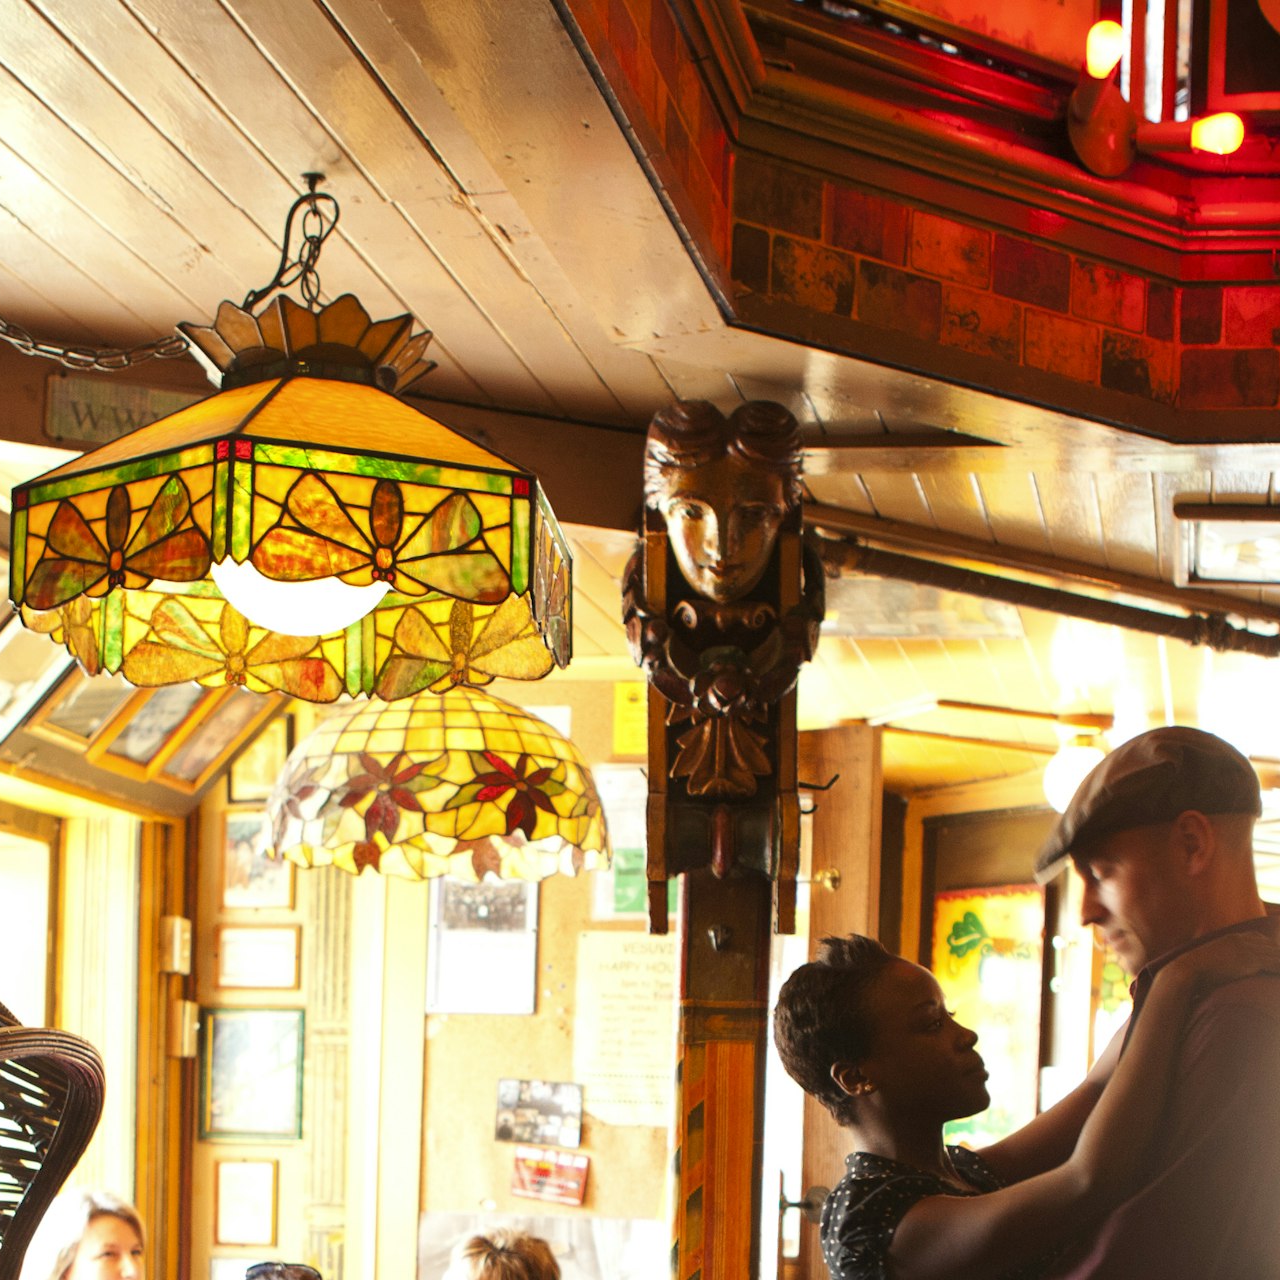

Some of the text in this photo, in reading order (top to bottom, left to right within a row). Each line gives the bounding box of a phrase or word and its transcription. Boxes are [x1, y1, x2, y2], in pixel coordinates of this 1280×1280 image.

[622, 943, 675, 955] VESUVI
[599, 960, 675, 974] HAPPY HOU
